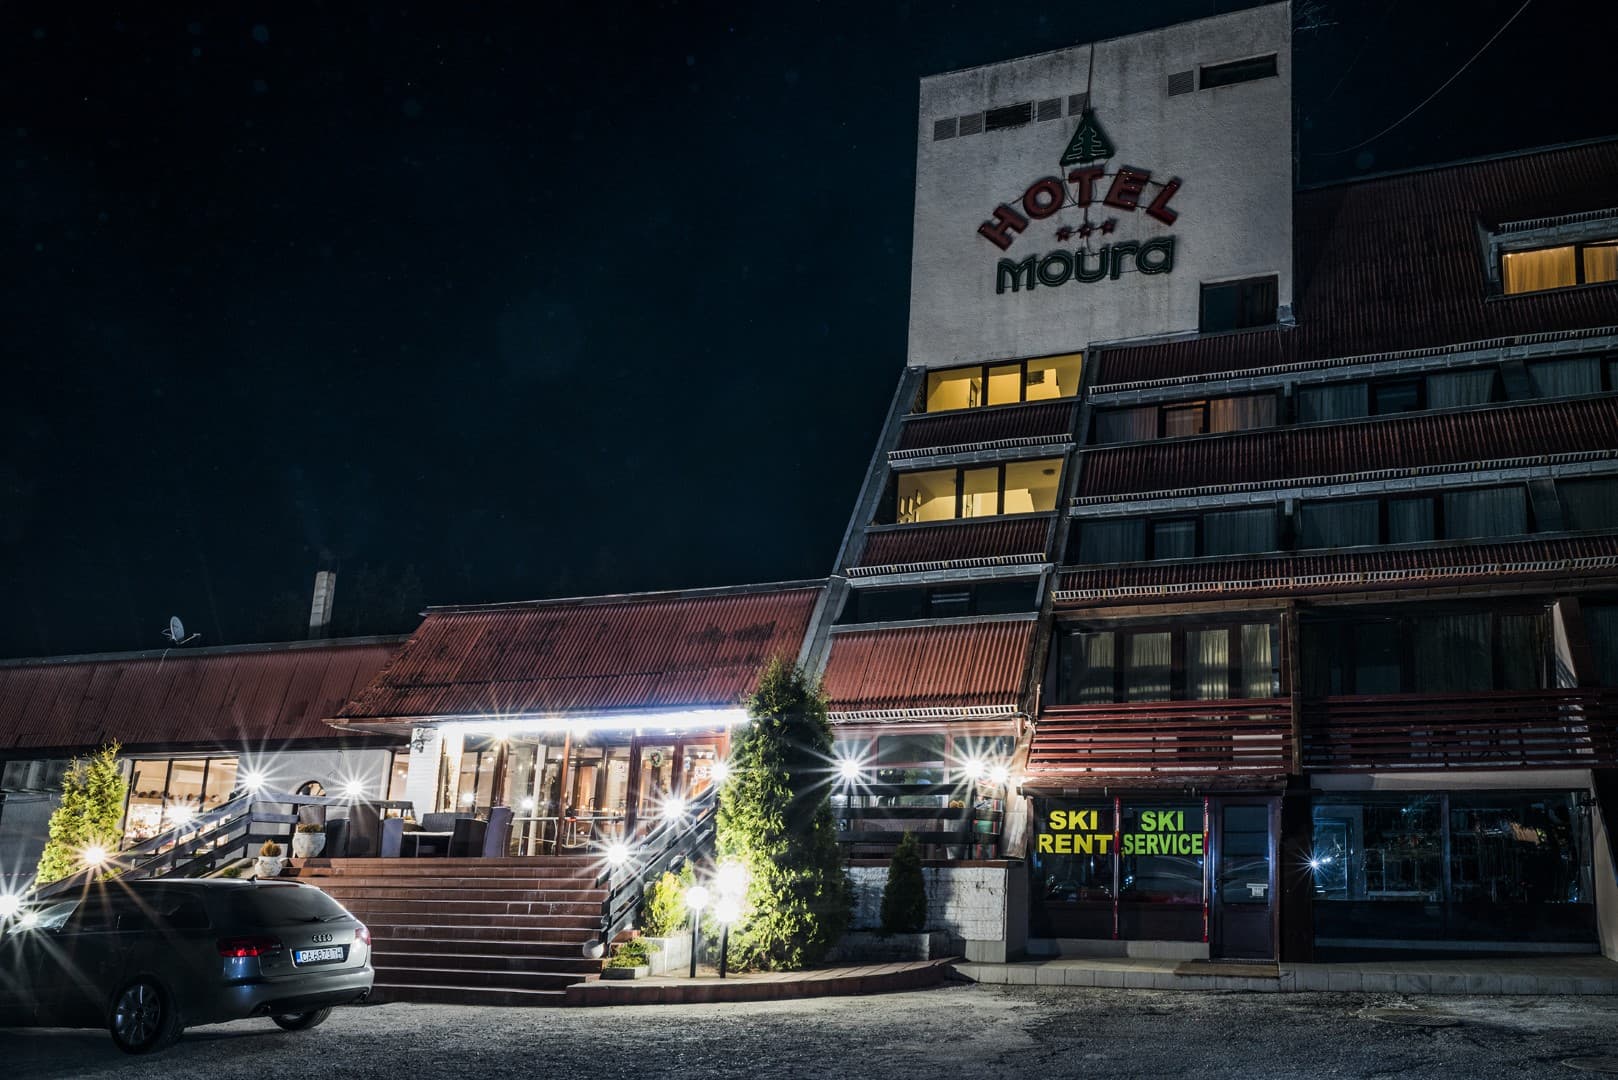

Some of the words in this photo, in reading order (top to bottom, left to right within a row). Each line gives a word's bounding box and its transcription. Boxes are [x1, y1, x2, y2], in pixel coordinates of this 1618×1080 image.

[977, 165, 1183, 251] HOTEL
[1049, 810, 1098, 831] SKI
[1140, 810, 1184, 832] SKI
[1038, 833, 1114, 855] RENT
[1123, 833, 1204, 855] SERVICE
